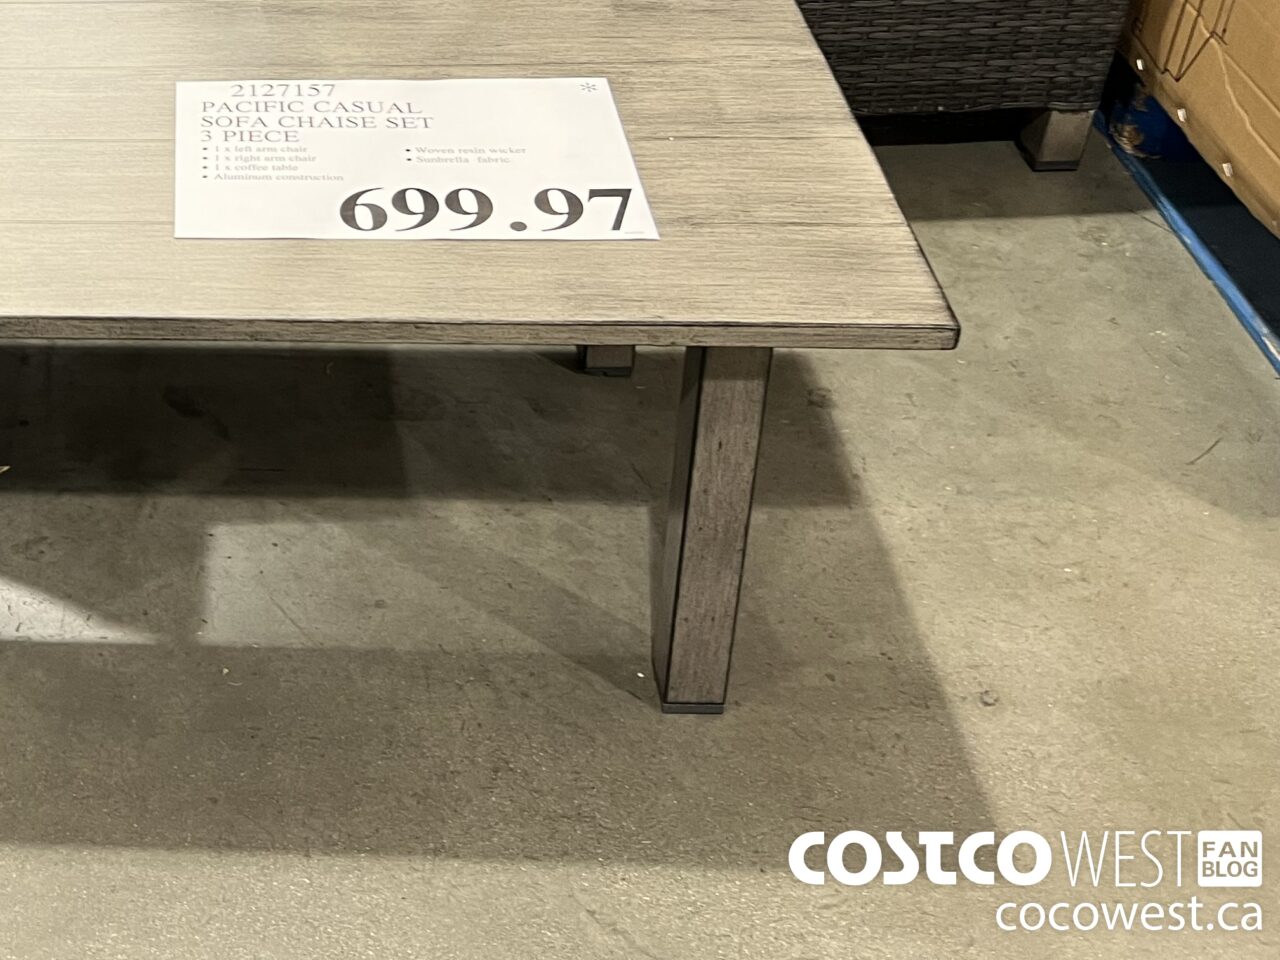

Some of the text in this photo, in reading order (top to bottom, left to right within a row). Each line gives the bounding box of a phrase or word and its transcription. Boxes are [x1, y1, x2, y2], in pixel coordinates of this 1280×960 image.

[230, 83, 337, 98] 2127157
[201, 100, 424, 114] PACIFIC CASUAL
[200, 115, 435, 130] SOFA CHAISE SET
[200, 130, 301, 143] 3 PIECE
[234, 145, 253, 153] left
[280, 145, 308, 153] chair
[234, 155, 261, 164] right
[289, 154, 318, 162] chair
[477, 156, 511, 164] fabric
[234, 164, 269, 172] coffee
[272, 164, 299, 172] table
[214, 173, 345, 182] Aluminum construction
[339, 186, 633, 233] 699.97
